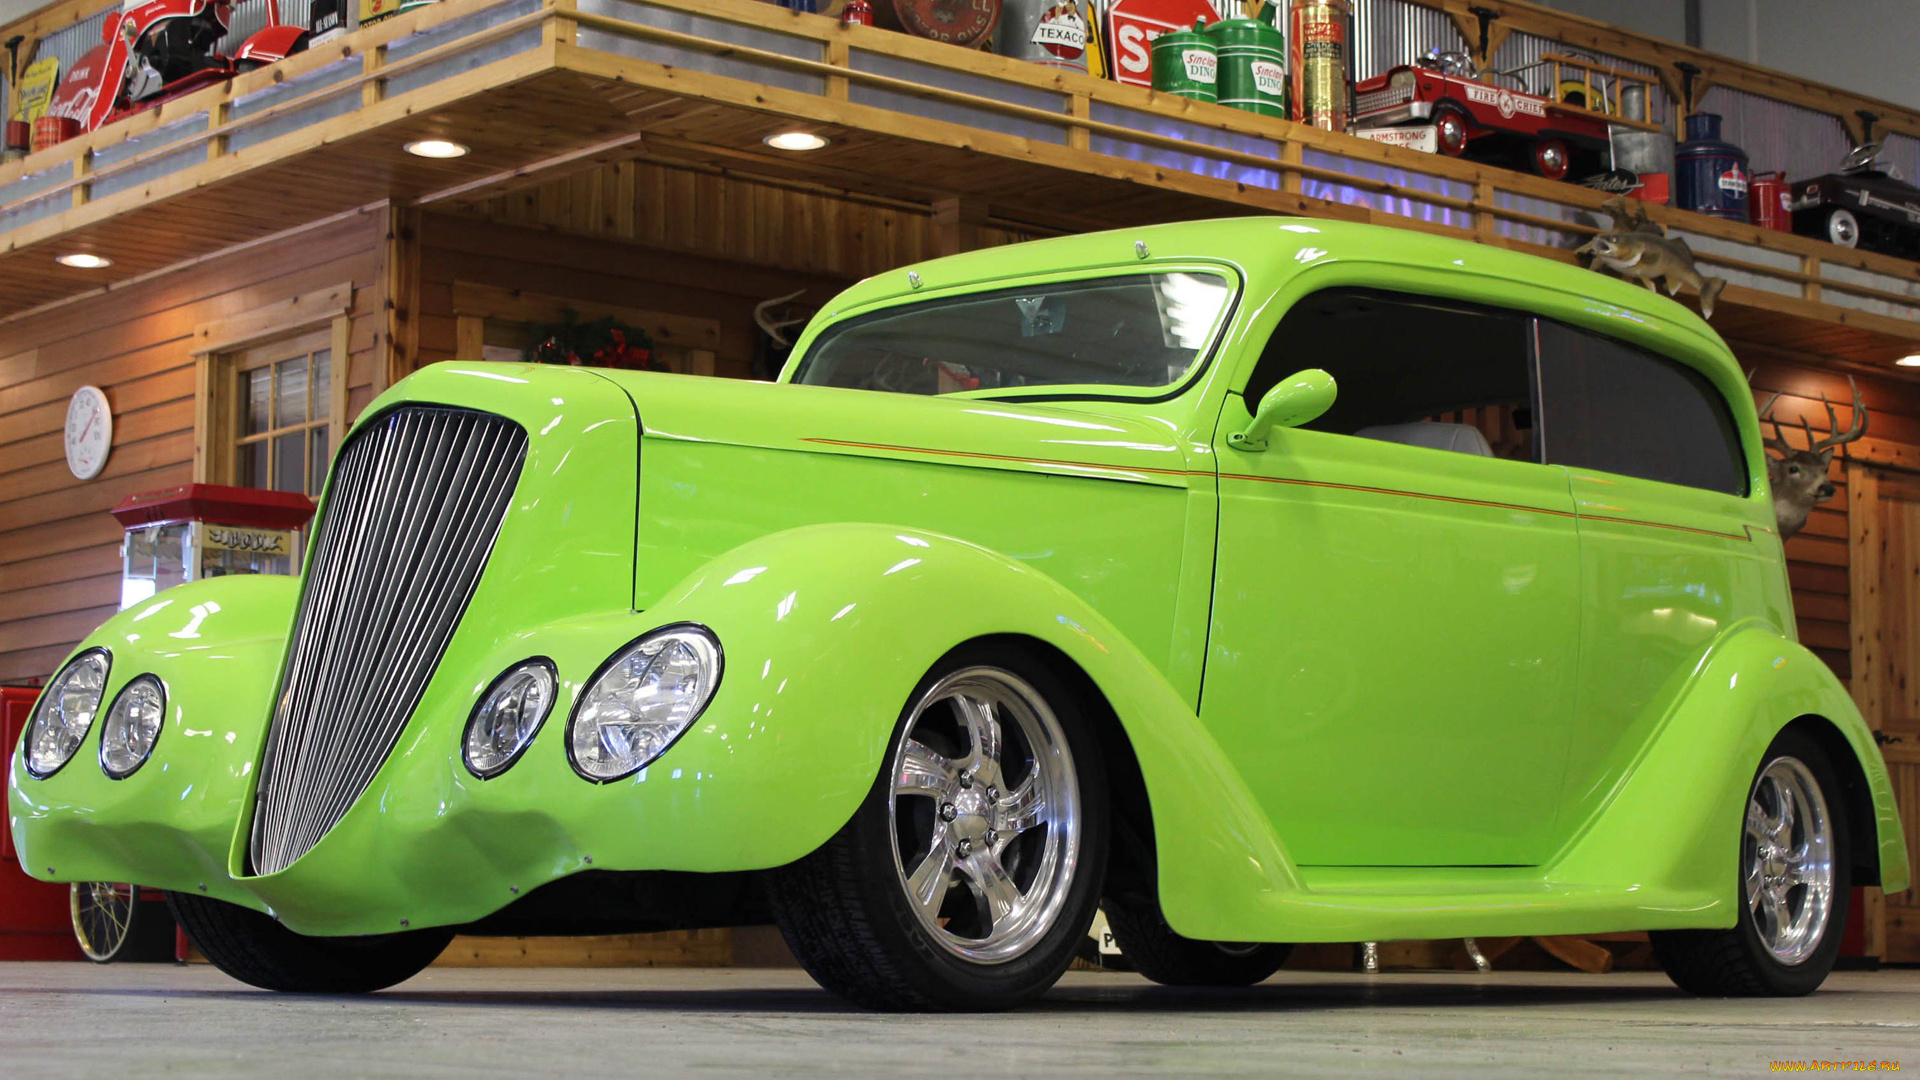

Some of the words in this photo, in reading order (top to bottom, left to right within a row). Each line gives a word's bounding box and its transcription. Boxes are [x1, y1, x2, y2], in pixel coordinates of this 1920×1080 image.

[957, 14, 987, 41] OILS
[1040, 27, 1084, 46] TEXACO
[1190, 65, 1215, 79] DINO
[1259, 77, 1281, 90] DINO
[1474, 91, 1495, 103] FIRE
[1517, 100, 1544, 114] CHIEF
[1370, 131, 1426, 142] ARMSTRONG
